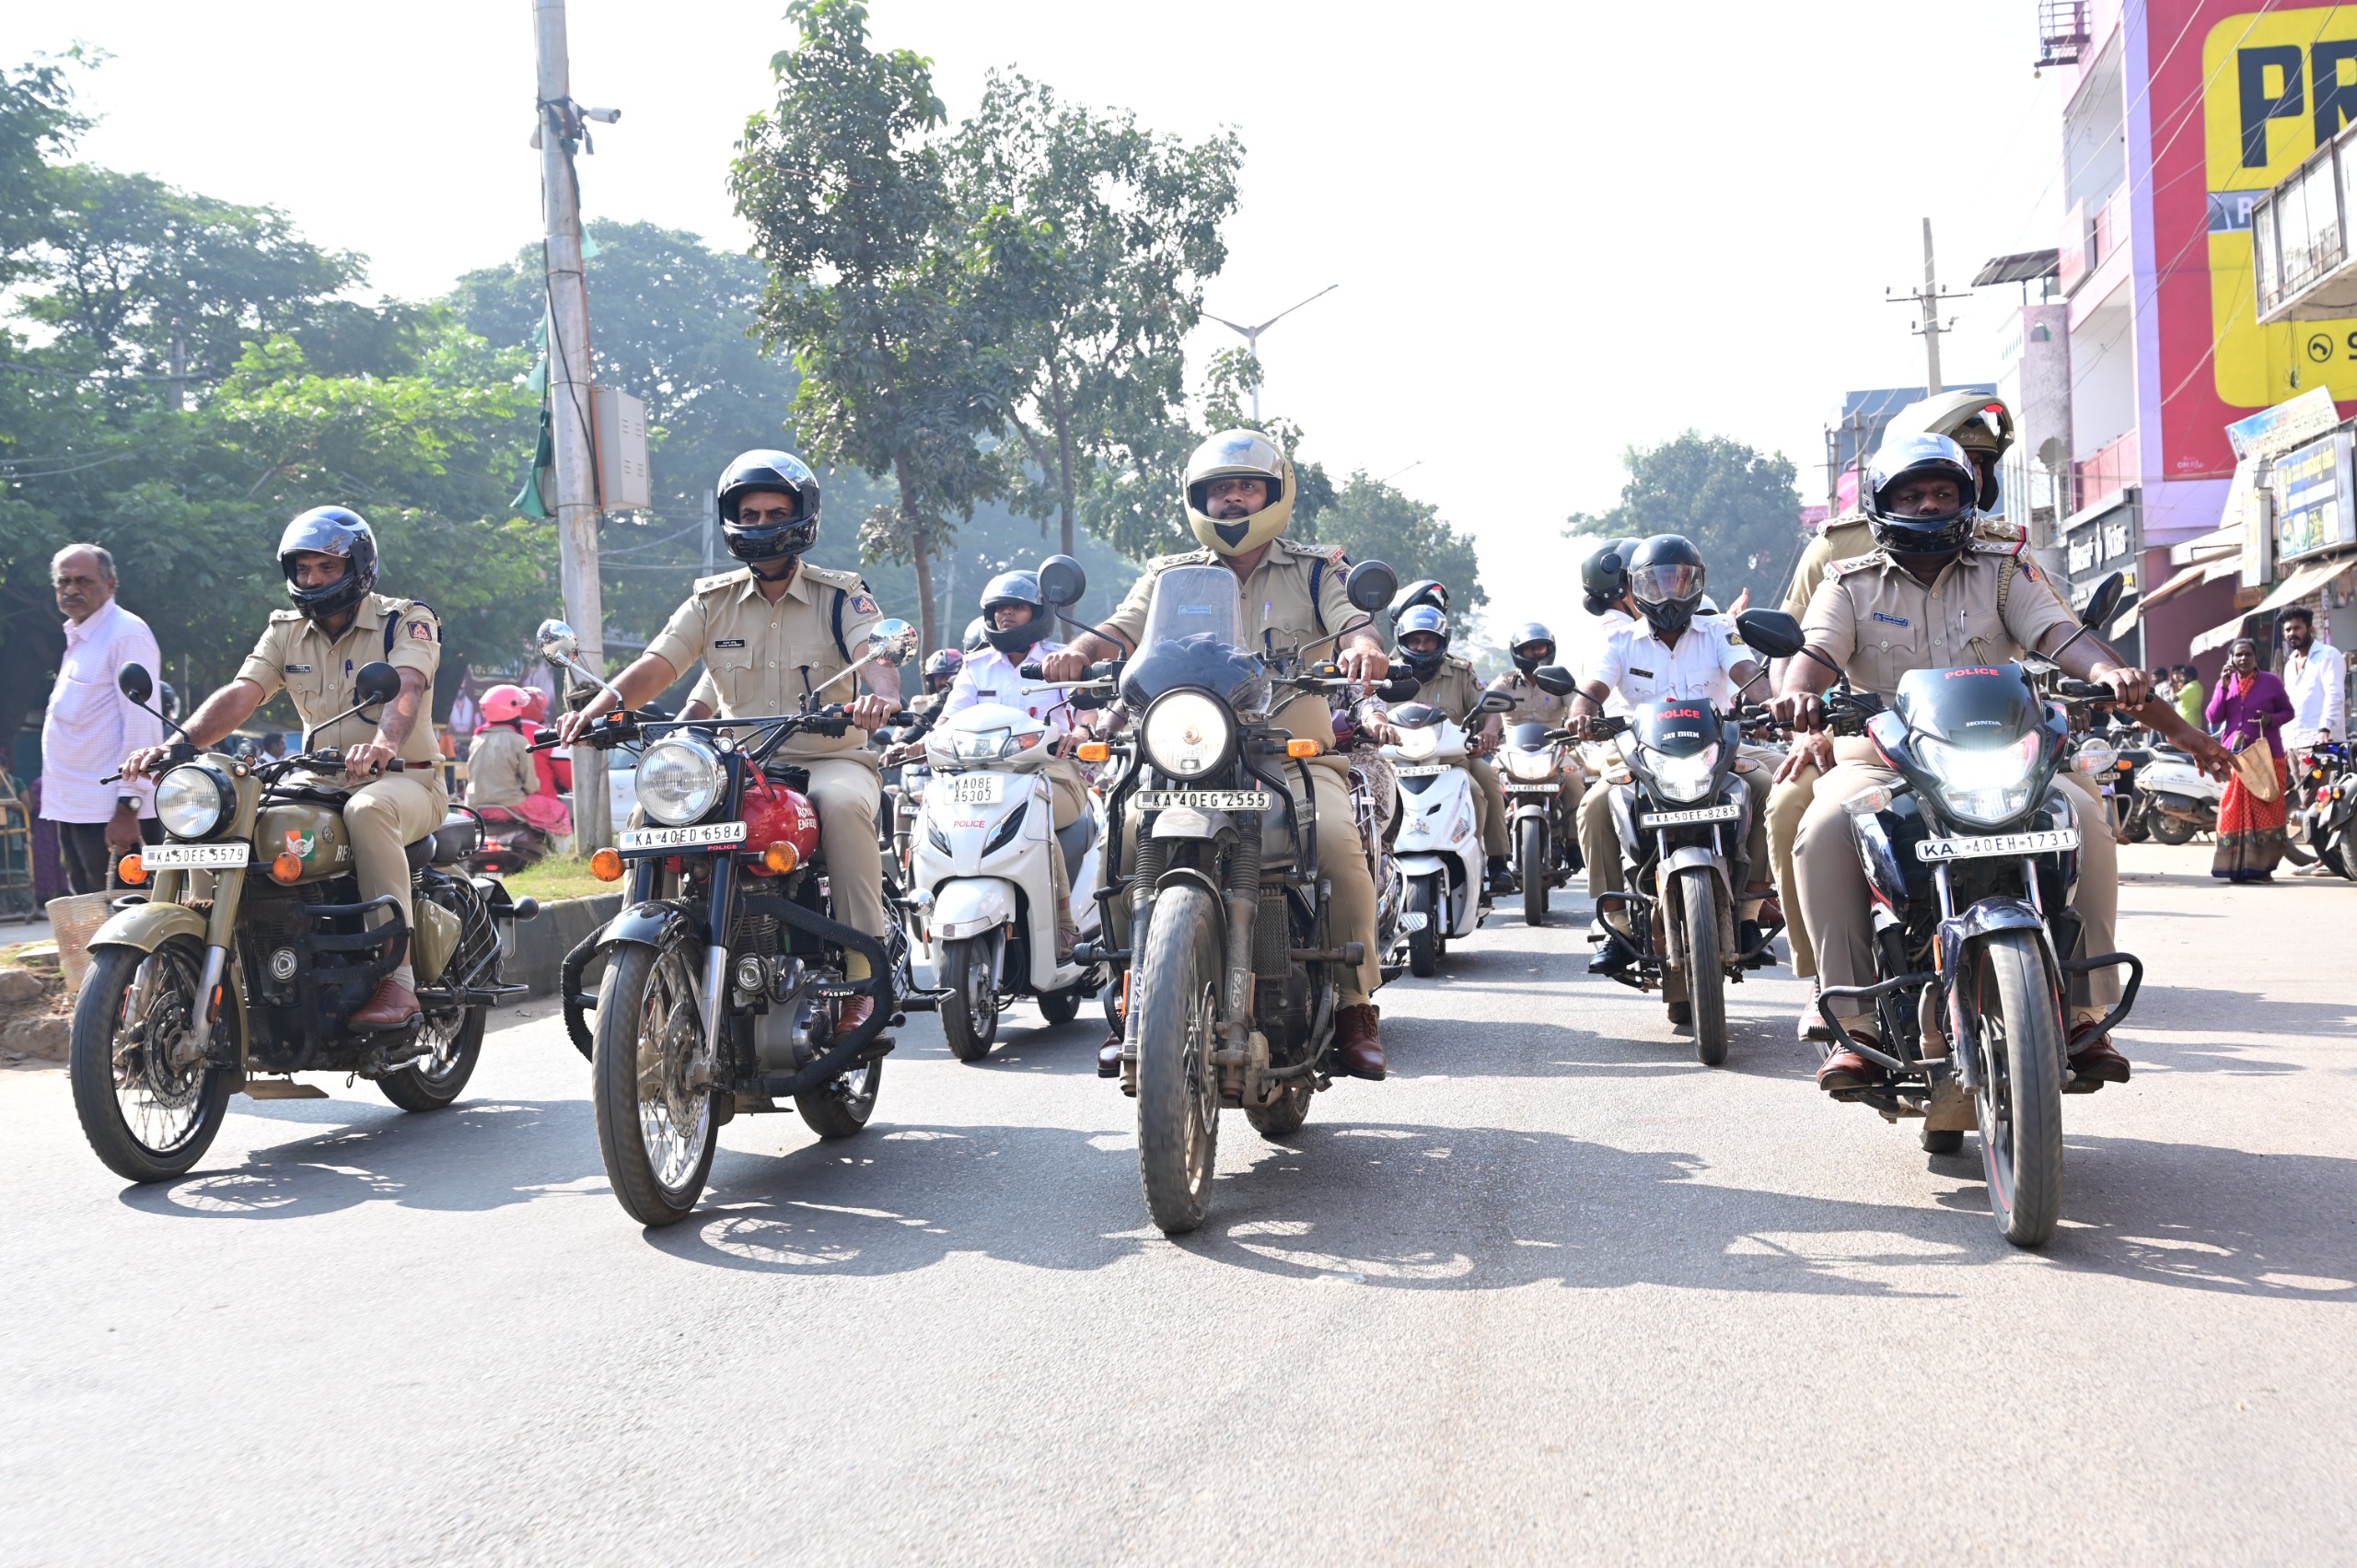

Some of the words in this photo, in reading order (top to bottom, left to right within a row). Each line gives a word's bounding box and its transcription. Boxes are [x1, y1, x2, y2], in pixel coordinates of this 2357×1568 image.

[1945, 668, 2000, 680] POLICE
[1656, 708, 1701, 722] POLICE
[954, 790, 992, 802] A5303
[795, 804, 815, 818] ROYAL
